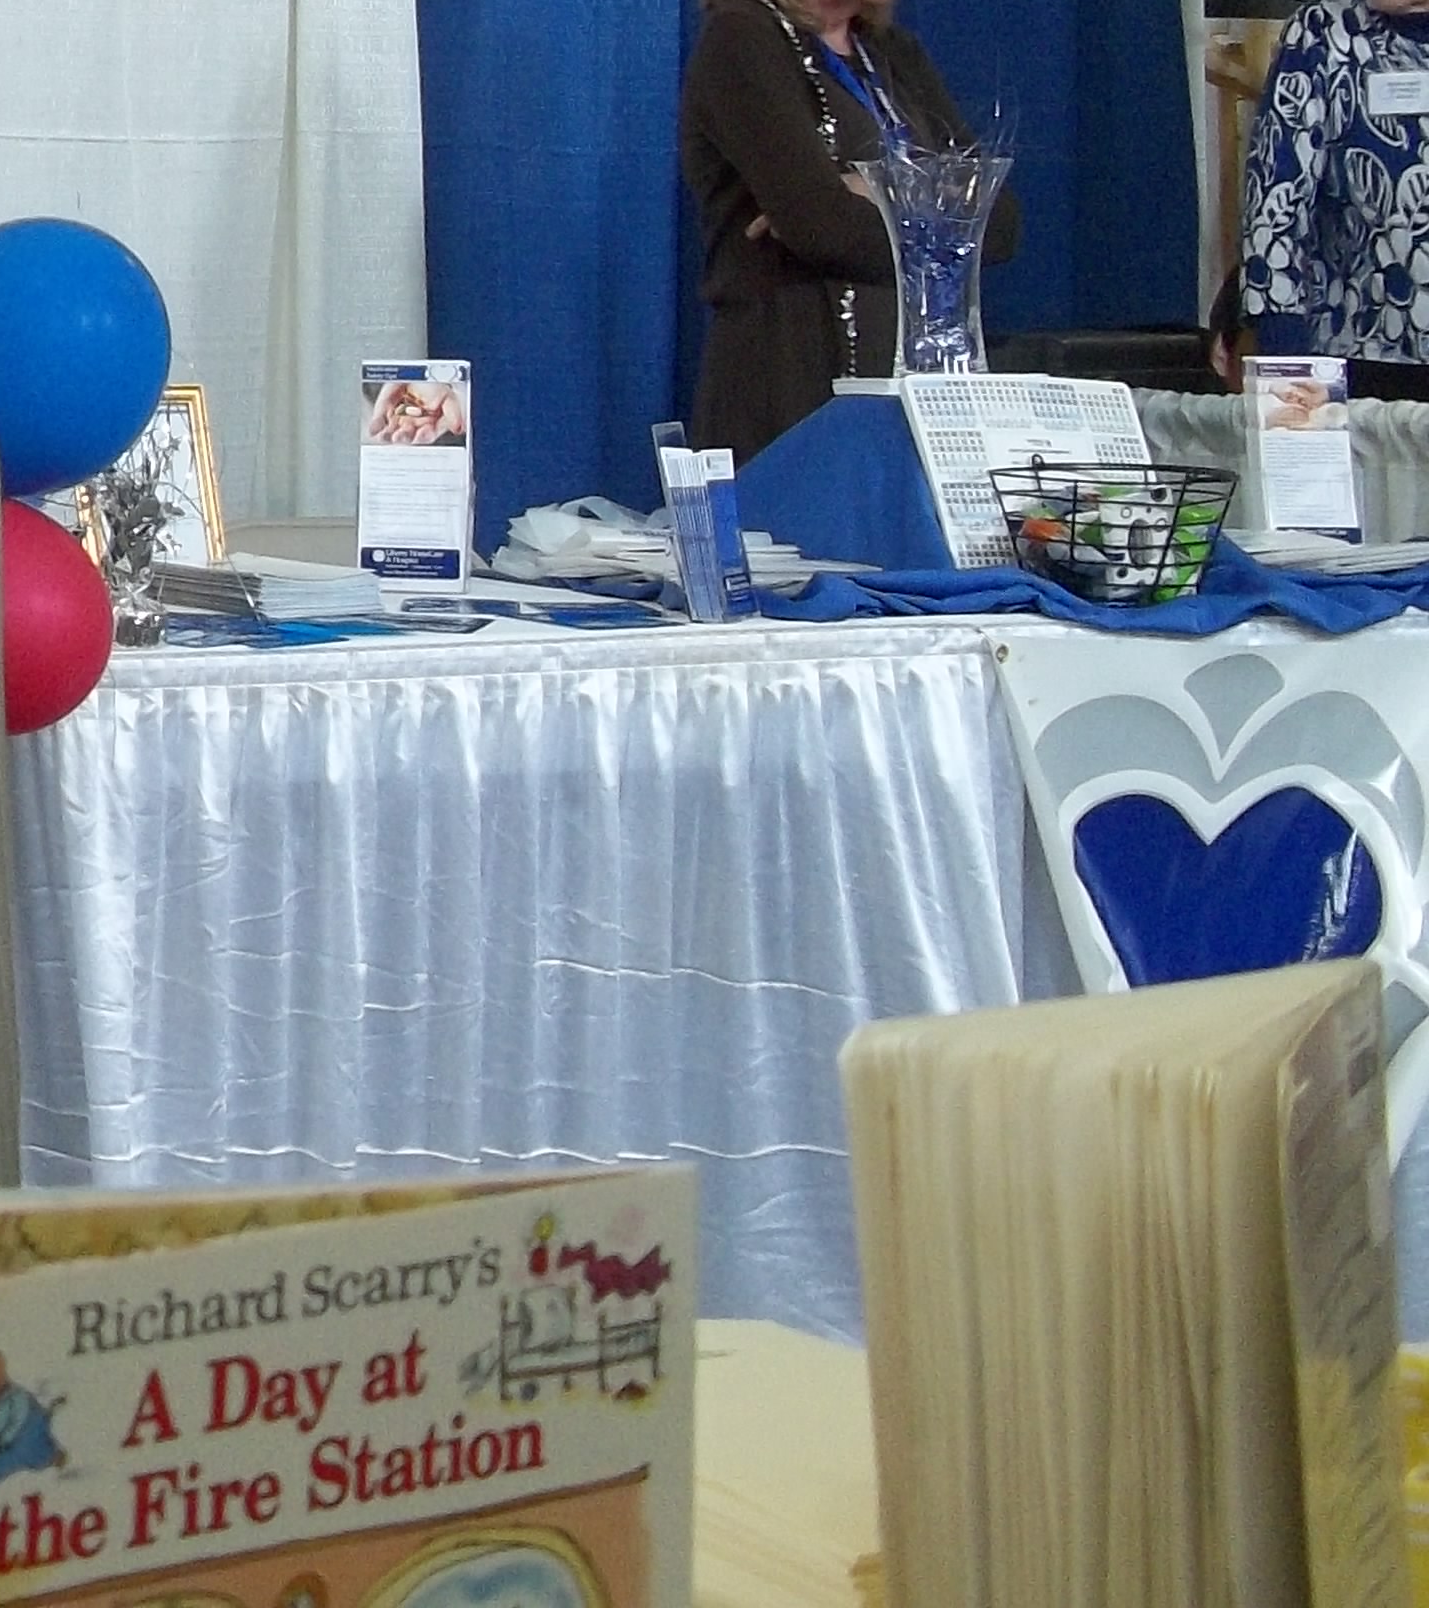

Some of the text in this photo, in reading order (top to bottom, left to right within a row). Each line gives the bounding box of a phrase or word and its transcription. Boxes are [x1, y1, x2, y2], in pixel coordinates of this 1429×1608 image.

[68, 1236, 503, 1357] Richard Scarry's
[121, 1328, 428, 1449] A Day at
[125, 1461, 282, 1550] Fire
[306, 1413, 547, 1513] Station
